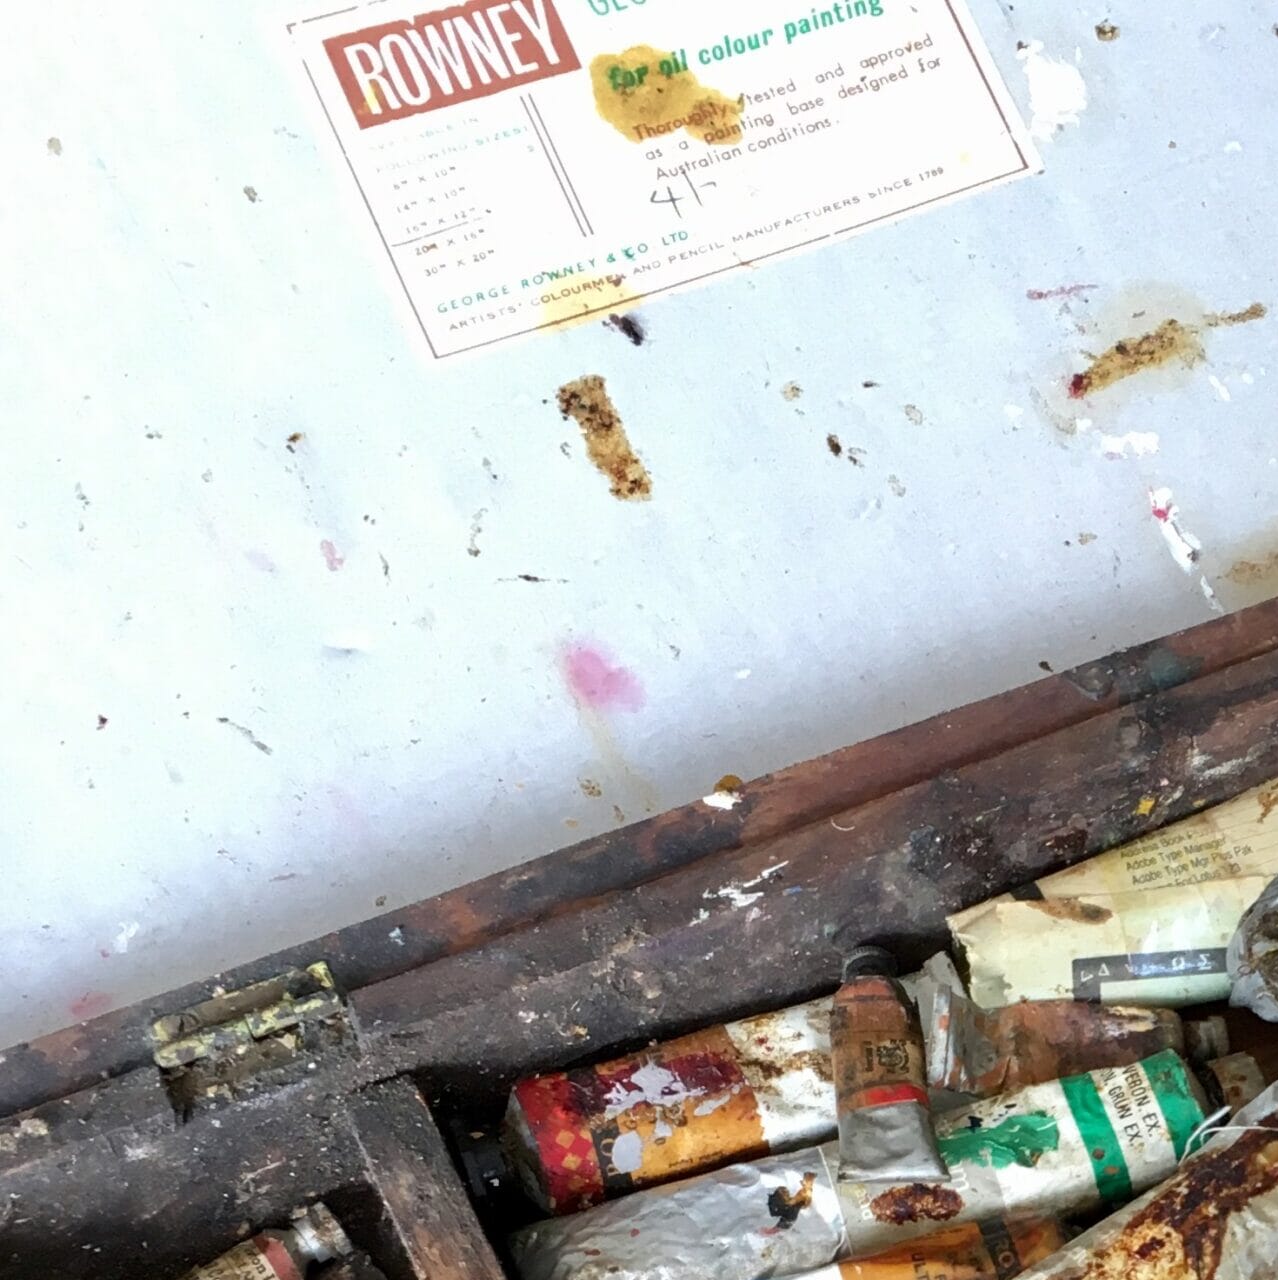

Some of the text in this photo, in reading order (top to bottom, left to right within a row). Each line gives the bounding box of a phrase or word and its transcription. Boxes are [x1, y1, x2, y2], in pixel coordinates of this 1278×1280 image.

[344, 0, 559, 115] ROWNEY
[608, 0, 885, 92] for oil colour painting
[632, 33, 935, 141] Thoroughly tested and approved
[645, 55, 942, 161] as a painting base designed for
[656, 146, 741, 180] Australian
[437, 284, 510, 314] GEORGE
[521, 258, 596, 289] ROWNEY
[662, 230, 689, 247] LTD
[530, 273, 627, 306] COLOURMEN
[633, 260, 661, 275] AND
[668, 243, 724, 265] PENCIL
[732, 195, 861, 244] MANUFACTURERS
[868, 178, 913, 199] SINCE
[1125, 837, 1226, 871] Adobe Type Manager
[1130, 869, 1163, 885] Adobe
[1164, 861, 1189, 877] Type
[1121, 1121, 1145, 1147] EX.
[1140, 1111, 1164, 1137] EX.
